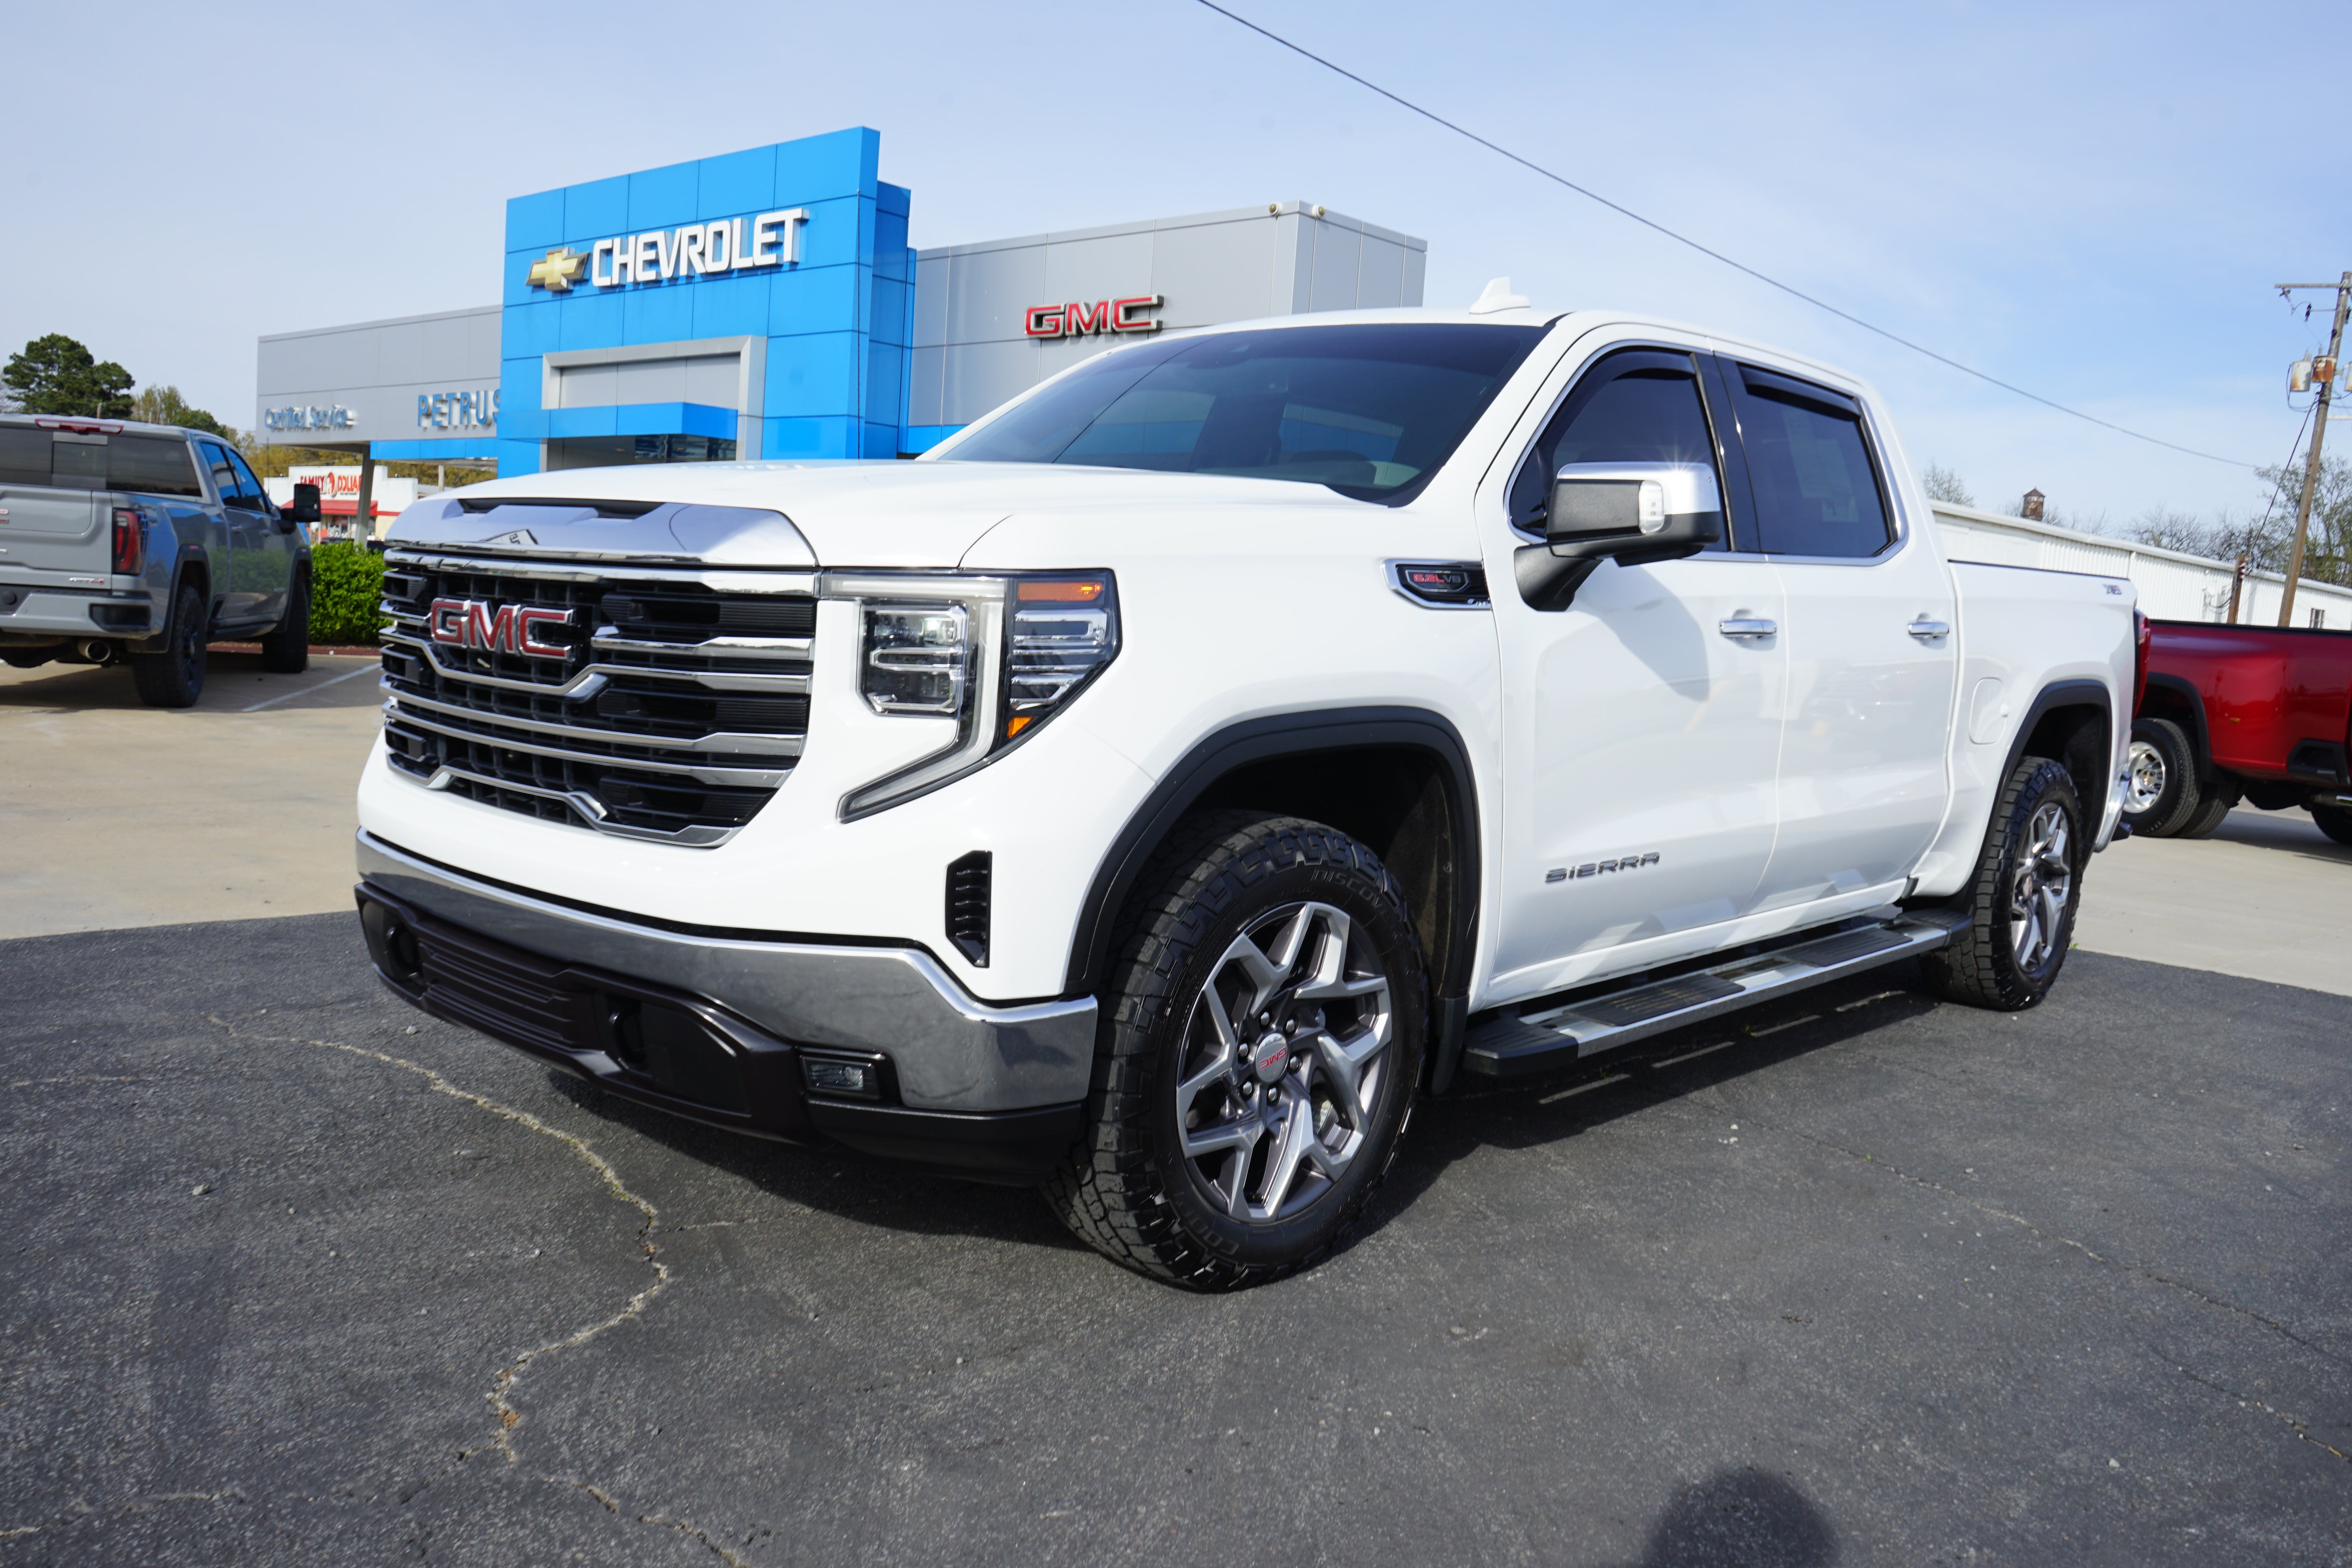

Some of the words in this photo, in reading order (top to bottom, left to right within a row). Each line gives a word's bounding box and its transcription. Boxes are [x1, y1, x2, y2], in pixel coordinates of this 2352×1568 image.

[592, 208, 810, 287] CHEVROLET
[1024, 294, 1163, 338] GMC
[265, 405, 307, 429] Certified
[309, 404, 350, 427] Service
[417, 388, 500, 428] PETRUS
[431, 597, 575, 662] GMC
[1544, 851, 1660, 883] SIERRA
[1259, 1045, 1287, 1070] GMC
